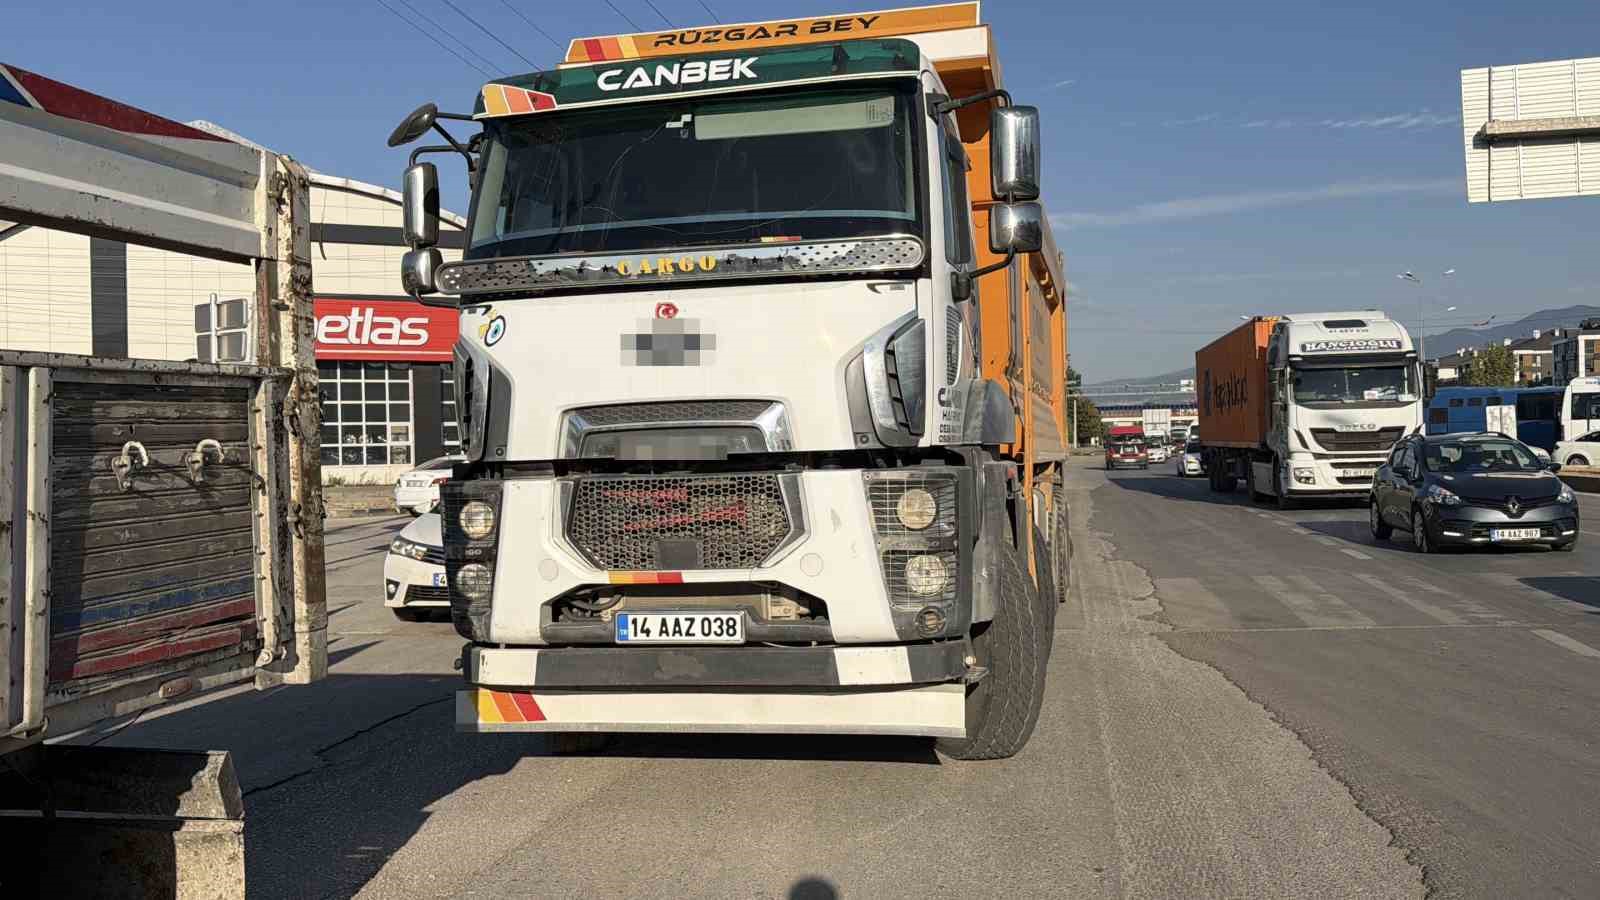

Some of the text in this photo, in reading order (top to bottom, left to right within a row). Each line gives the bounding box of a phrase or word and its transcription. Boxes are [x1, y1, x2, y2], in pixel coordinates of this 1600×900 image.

[654, 15, 881, 47] RÜZGAR BEY
[596, 57, 760, 92] CANBEK
[617, 254, 718, 277] CARGO
[314, 306, 430, 346] etlas
[631, 617, 652, 637] 14
[658, 616, 696, 637] AAZ
[700, 617, 737, 637] 038
